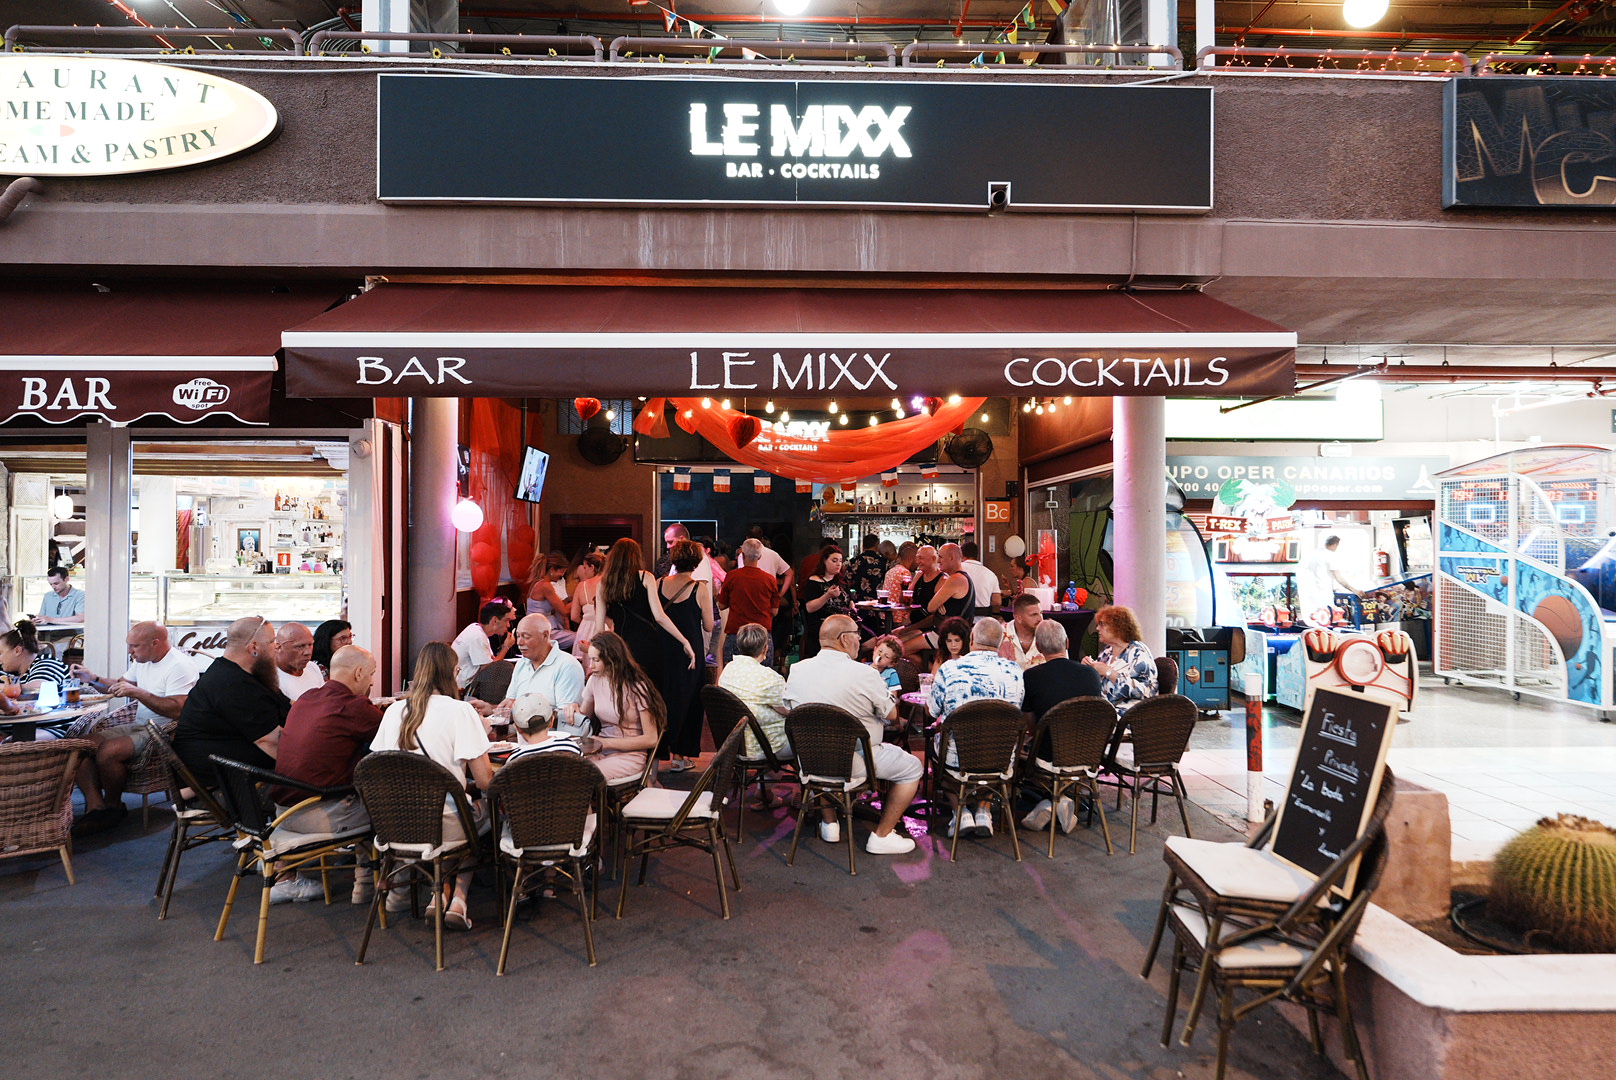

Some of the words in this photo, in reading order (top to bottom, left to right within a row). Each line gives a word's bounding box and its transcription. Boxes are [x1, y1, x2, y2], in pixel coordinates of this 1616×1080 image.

[0, 101, 51, 121] ME
[64, 101, 155, 121] MADE
[690, 103, 760, 156] LE
[770, 104, 913, 158] MIXX
[71, 144, 91, 164] &
[105, 126, 218, 163] PASTRY
[726, 162, 763, 178] BAR
[780, 163, 880, 179] COCKTAILS
[356, 356, 473, 385] BAR
[689, 352, 758, 390] LE
[772, 352, 898, 390] MIXX
[1004, 357, 1230, 387] COCKTAILS
[17, 377, 117, 410] BAR
[1217, 465, 1275, 479] OPER
[1284, 465, 1396, 481] CANARIOS
[987, 503, 1008, 520] Bc
[1271, 520, 1294, 531] PARK
[1321, 712, 1358, 741] Fiesta
